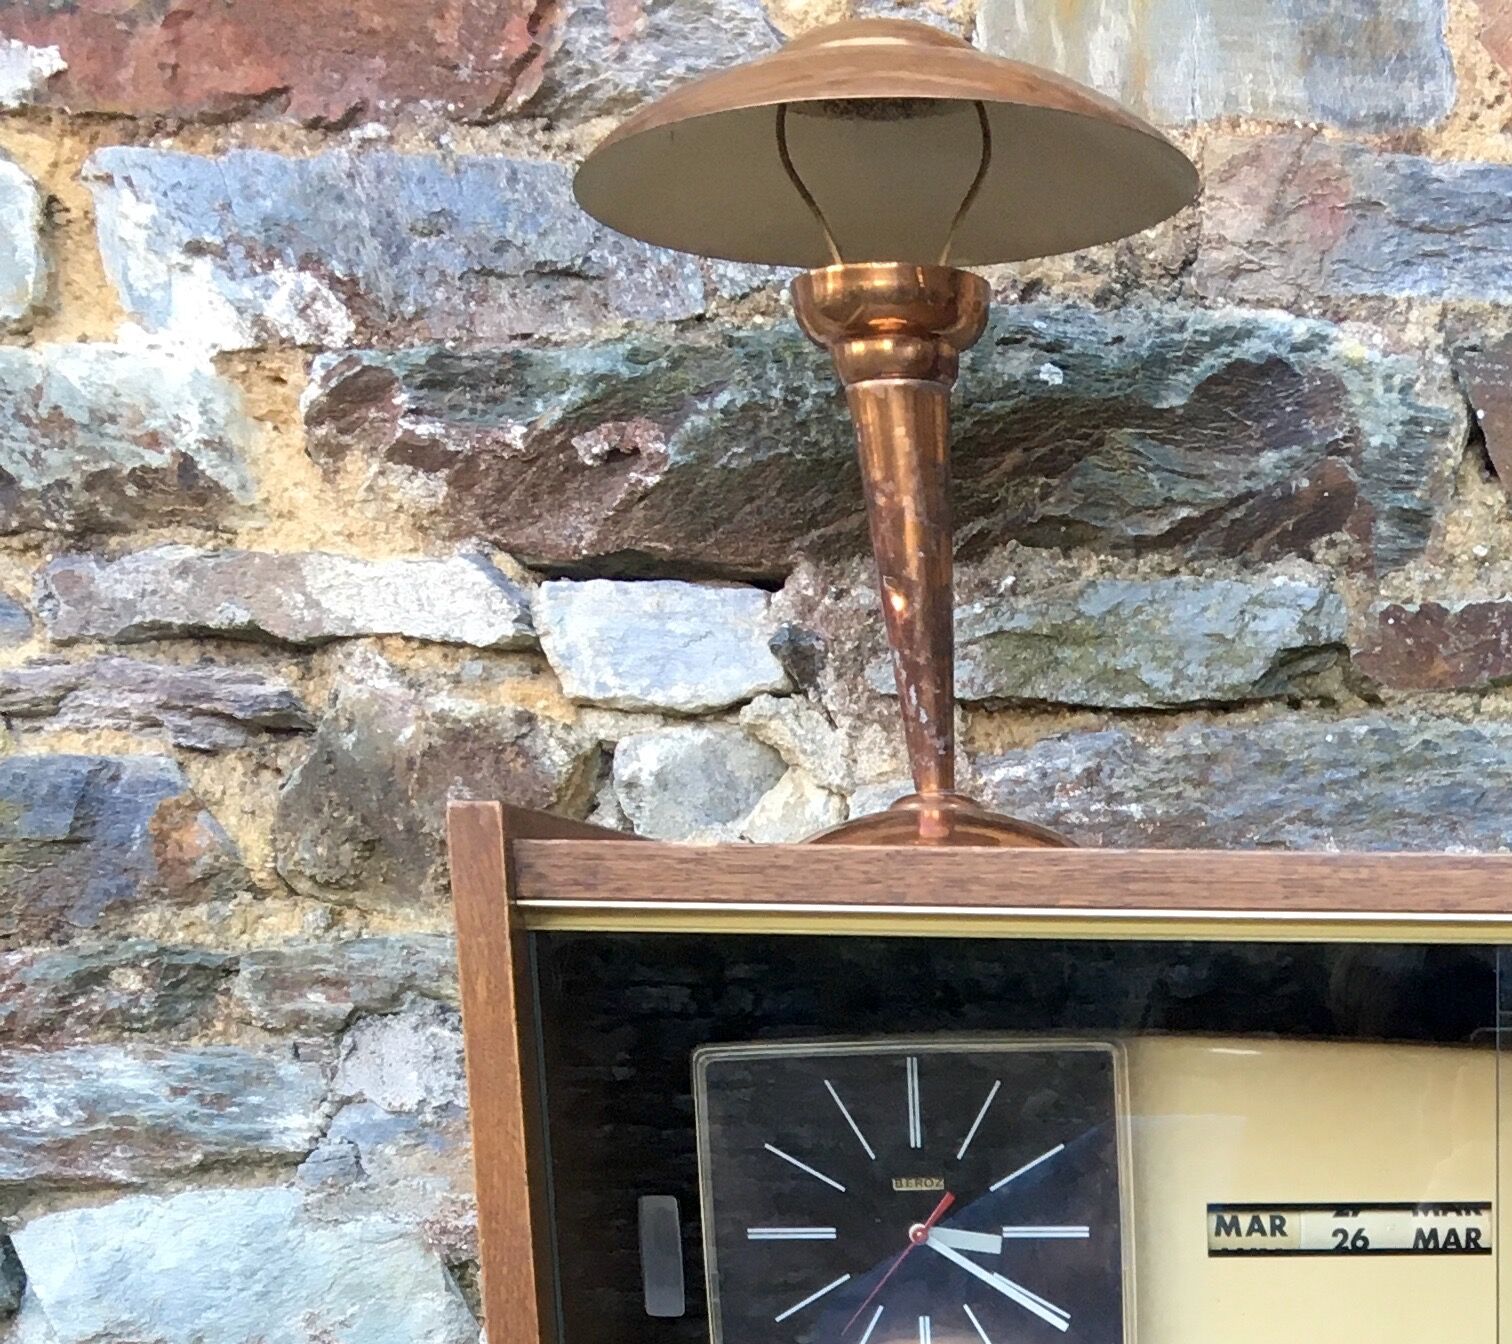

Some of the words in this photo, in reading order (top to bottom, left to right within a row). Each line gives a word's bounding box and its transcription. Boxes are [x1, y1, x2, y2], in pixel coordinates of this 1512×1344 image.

[1214, 1214, 1288, 1237] MAR
[1332, 1228, 1370, 1250] 26
[1412, 1228, 1482, 1249] MAR
